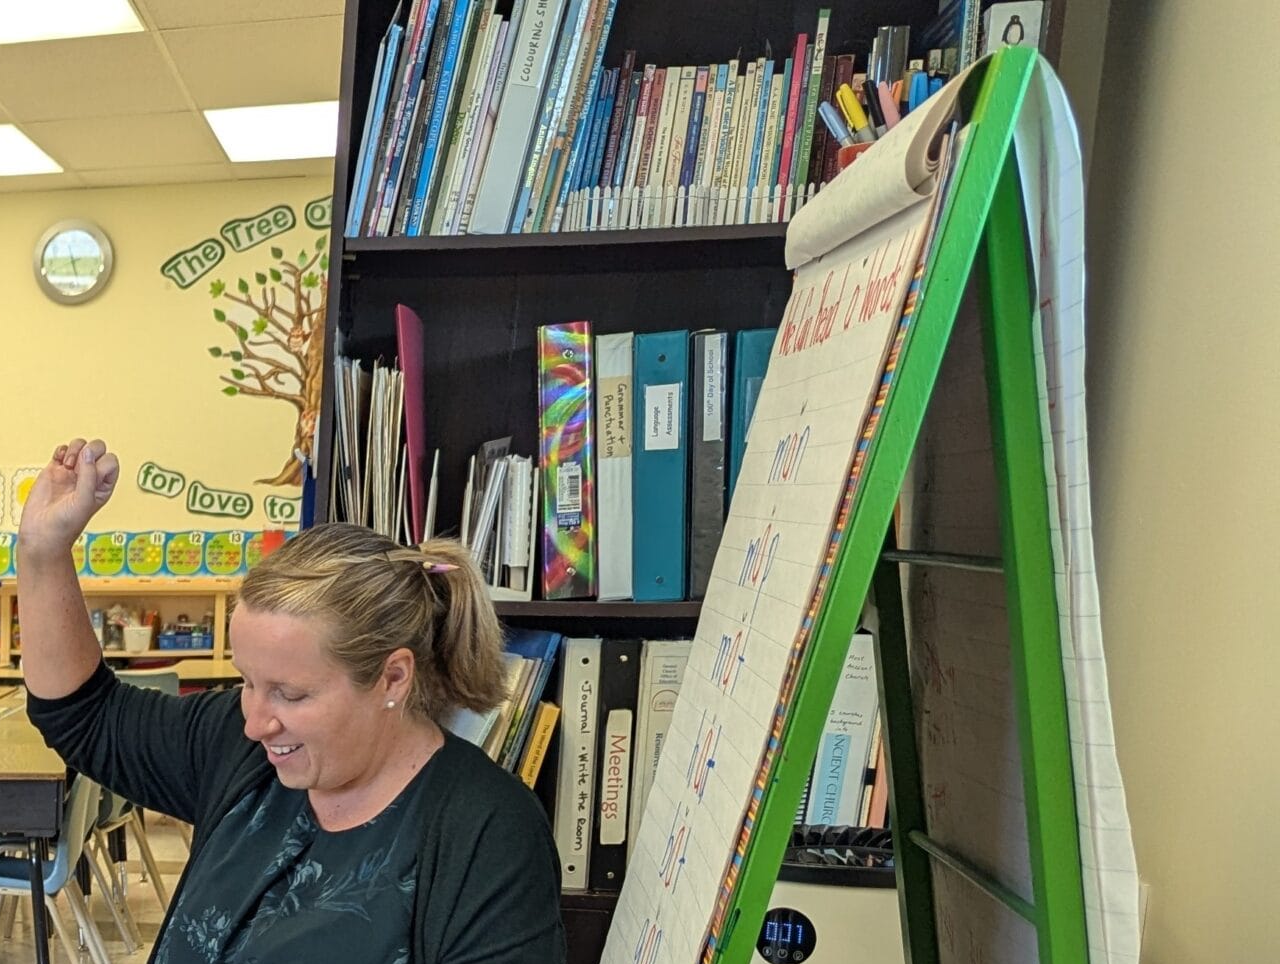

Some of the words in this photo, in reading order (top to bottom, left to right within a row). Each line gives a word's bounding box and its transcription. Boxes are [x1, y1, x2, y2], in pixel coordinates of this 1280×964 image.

[520, 20, 544, 82] COLOURING
[425, 71, 452, 149] KALEIDOSCOPES
[611, 108, 622, 134] SCHOOL
[805, 100, 815, 123] Apples
[535, 124, 547, 153] Animal
[644, 126, 653, 151] SCHOOL
[525, 154, 540, 188] Kingdom
[165, 243, 220, 284] The
[224, 209, 290, 249] Tree
[707, 349, 715, 371] School
[603, 394, 616, 458] Punctuation
[651, 406, 661, 438] Language
[665, 391, 675, 435] Assessments
[139, 465, 181, 494] for
[190, 485, 248, 514] love
[268, 500, 296, 519] to
[114, 534, 124, 544] 10
[153, 534, 162, 543] 11
[192, 533, 202, 543] 12
[231, 532, 242, 543] 13
[576, 752, 590, 786] Write
[600, 734, 627, 820] Meetings
[577, 790, 589, 811] the
[574, 817, 587, 851] Room
